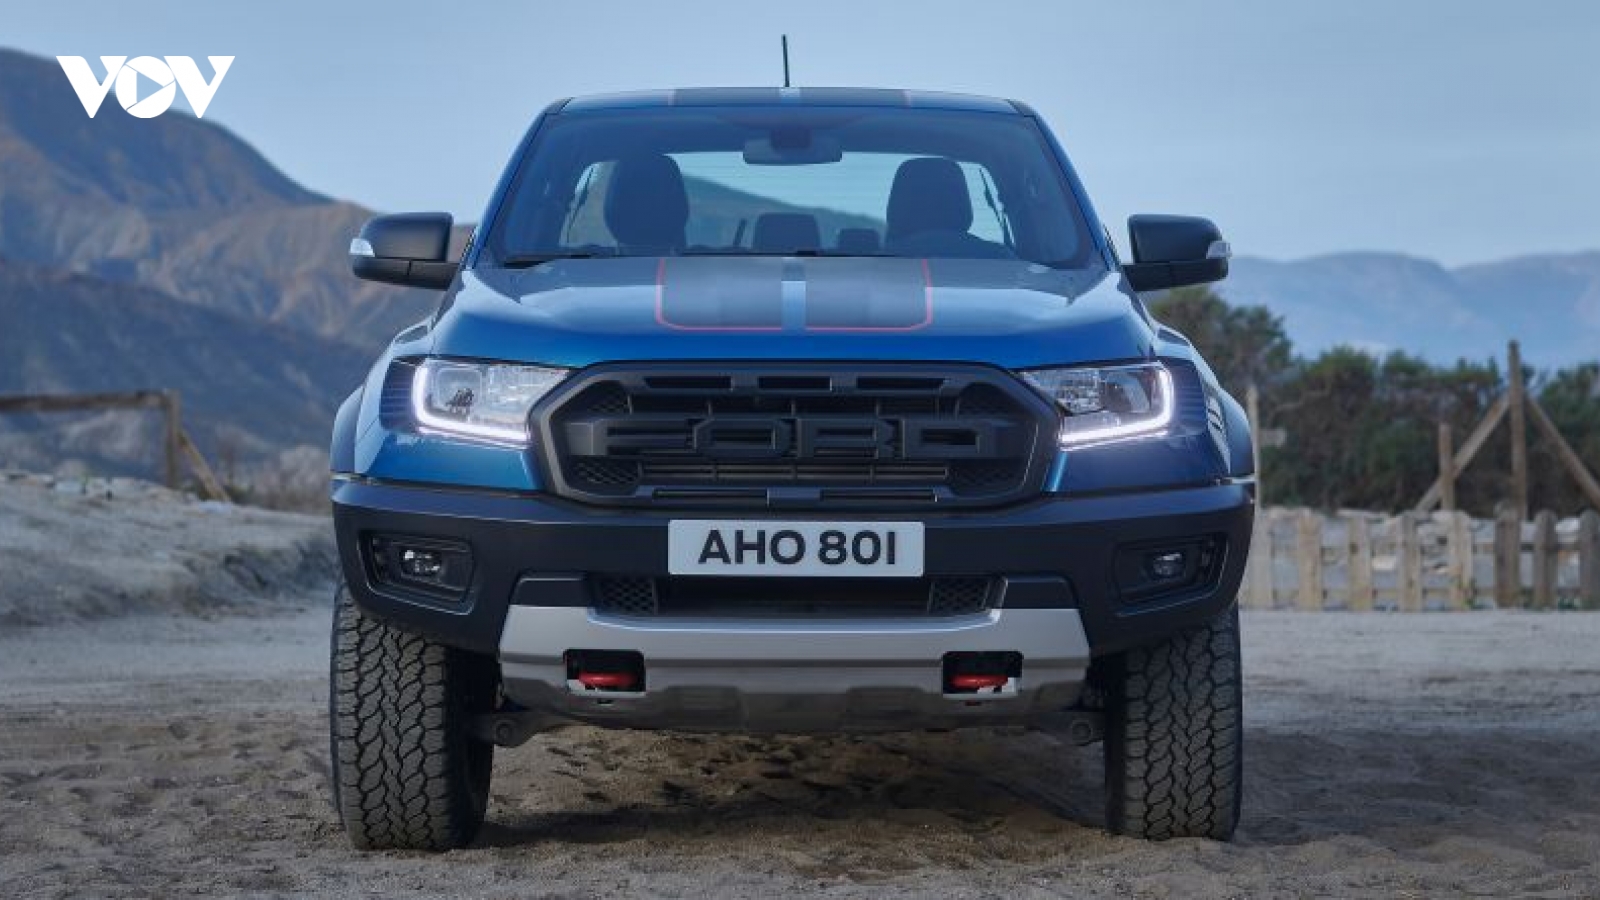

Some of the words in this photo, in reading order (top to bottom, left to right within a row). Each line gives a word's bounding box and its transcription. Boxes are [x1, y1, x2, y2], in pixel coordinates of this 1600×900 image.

[590, 416, 996, 459] FORD
[697, 529, 806, 566] AHO
[817, 529, 896, 566] 801
